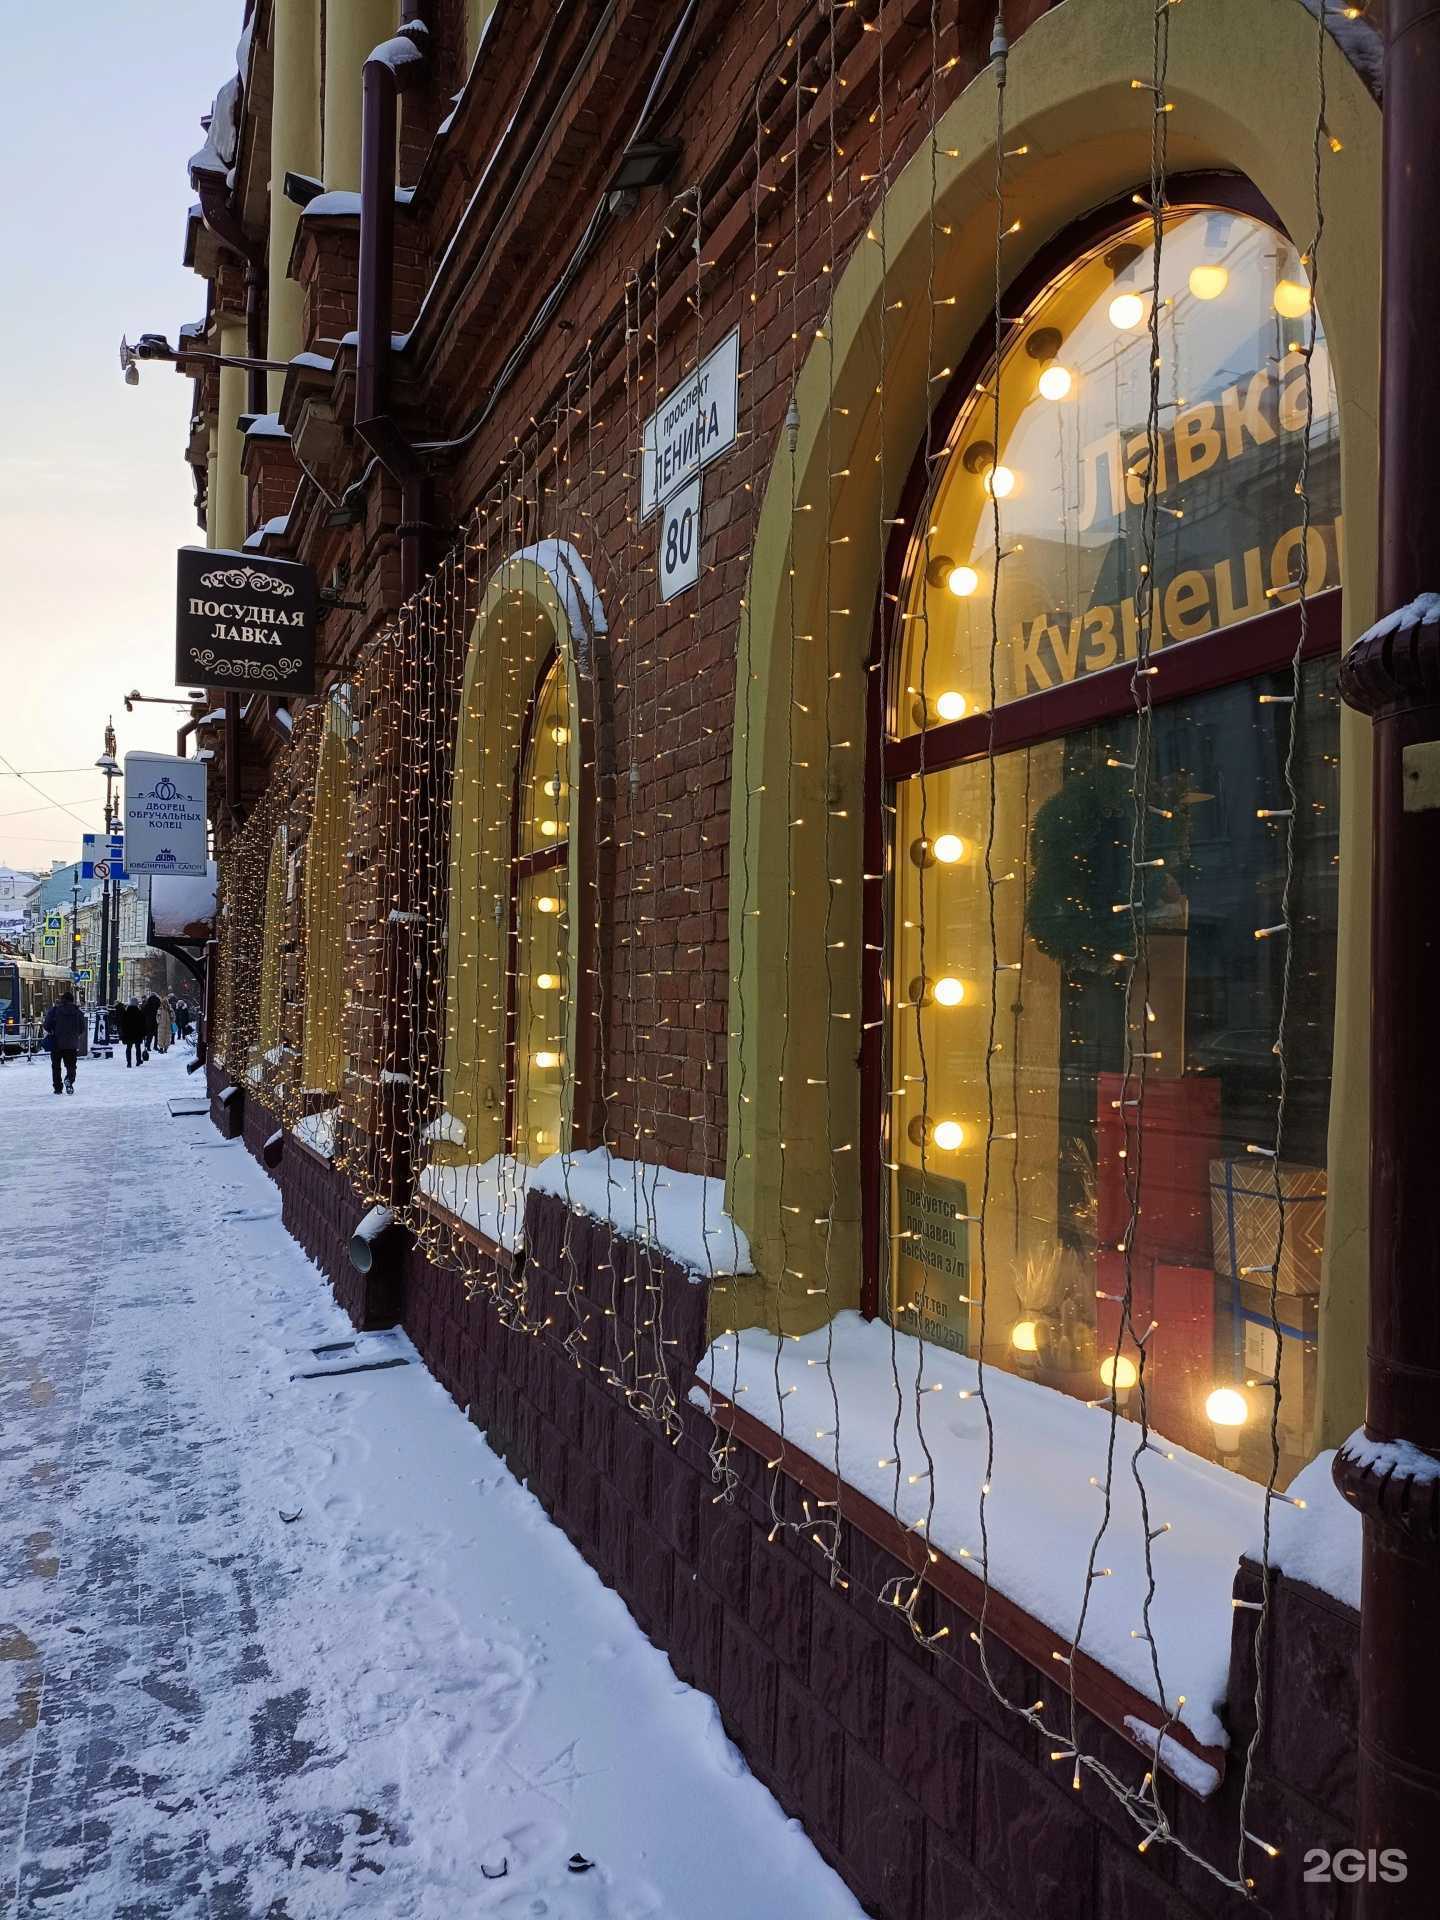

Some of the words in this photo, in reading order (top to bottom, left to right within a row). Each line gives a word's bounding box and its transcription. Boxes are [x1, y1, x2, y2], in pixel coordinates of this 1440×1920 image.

[664, 373, 710, 435] проспект
[654, 401, 720, 492] ЛЕНИНА
[1079, 349, 1328, 533] Лавка
[665, 506, 693, 575] 80
[188, 597, 305, 627] ПОСУДНАЯ
[211, 623, 283, 646] ЛАВКА
[128, 810, 201, 822] ОБРУЧАЛЬНЫХ
[145, 802, 185, 812] ДВОРЕЦ
[148, 820, 182, 830] КОЛЕЦ
